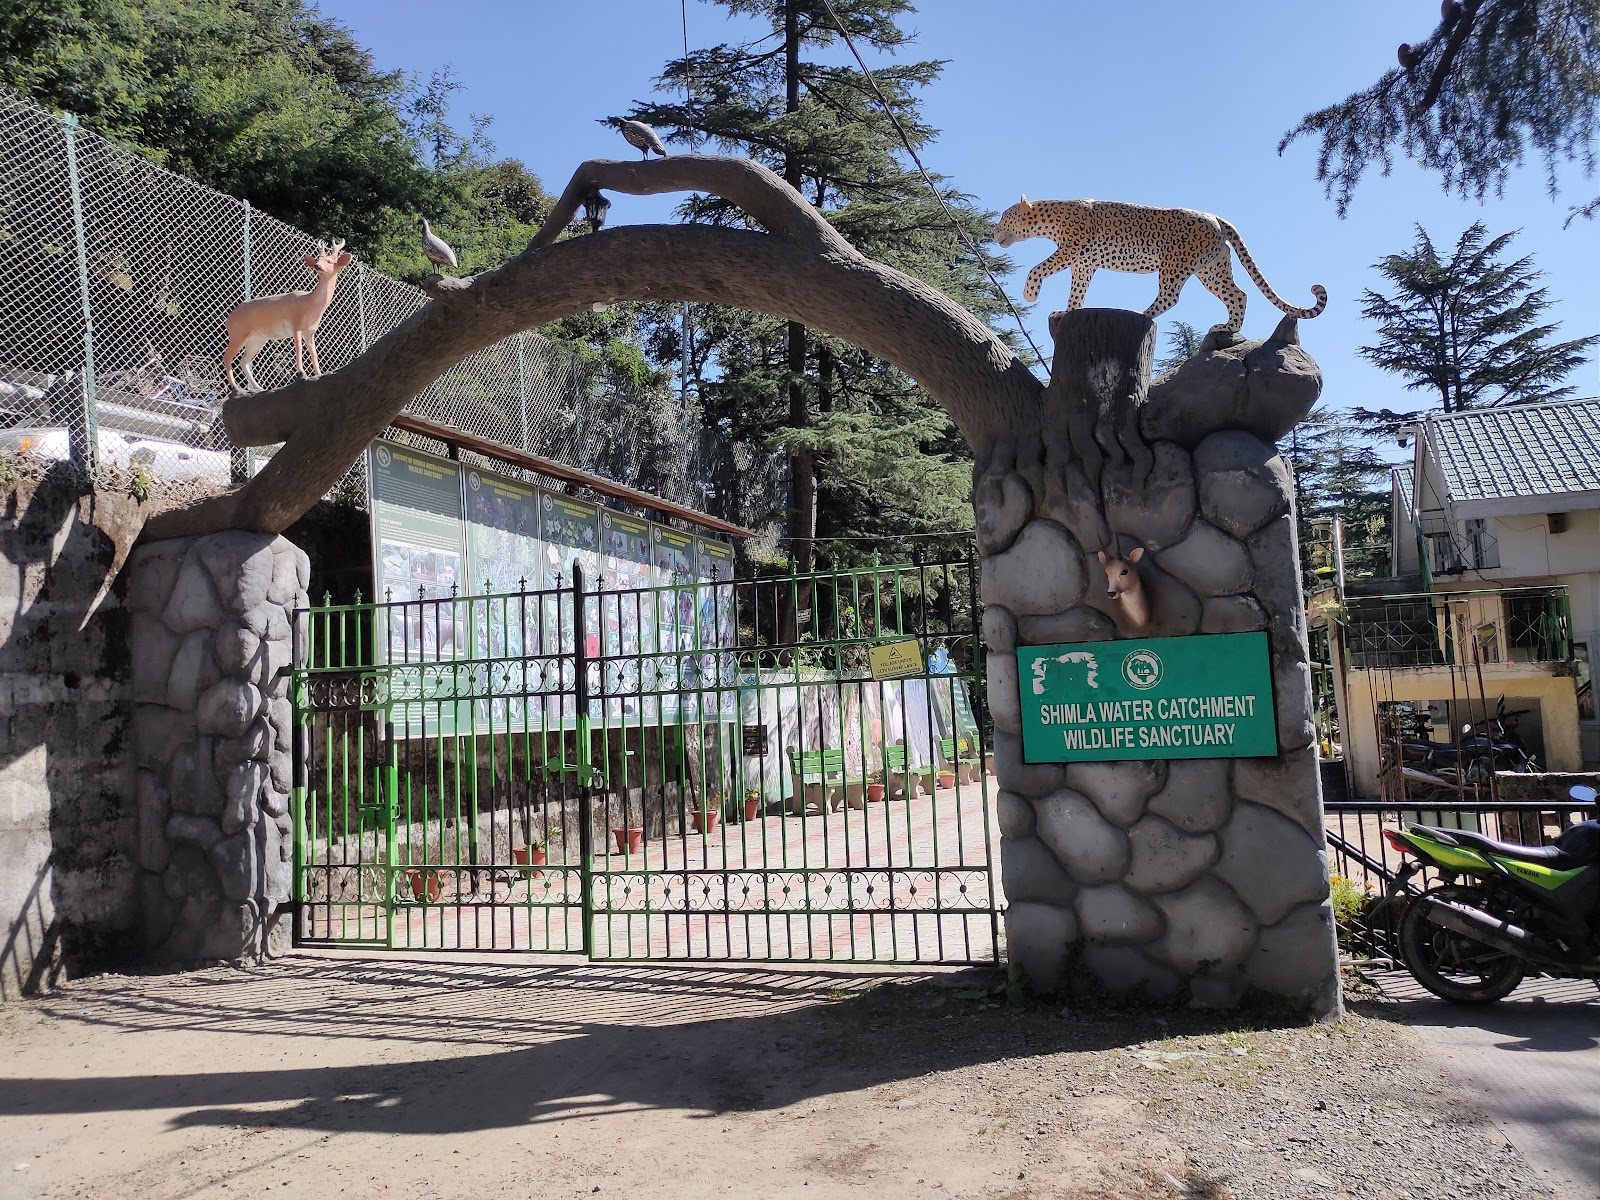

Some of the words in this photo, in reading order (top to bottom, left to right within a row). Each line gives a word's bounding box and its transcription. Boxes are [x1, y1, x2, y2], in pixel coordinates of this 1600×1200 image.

[1040, 702, 1098, 725] SHIMLA
[1099, 699, 1155, 723] WATER
[1157, 695, 1256, 720] CATCHMENT
[1063, 726, 1136, 750] WILDLIFE
[1139, 723, 1236, 748] SANCTUARY
[1516, 866, 1540, 878] YAMAHA
